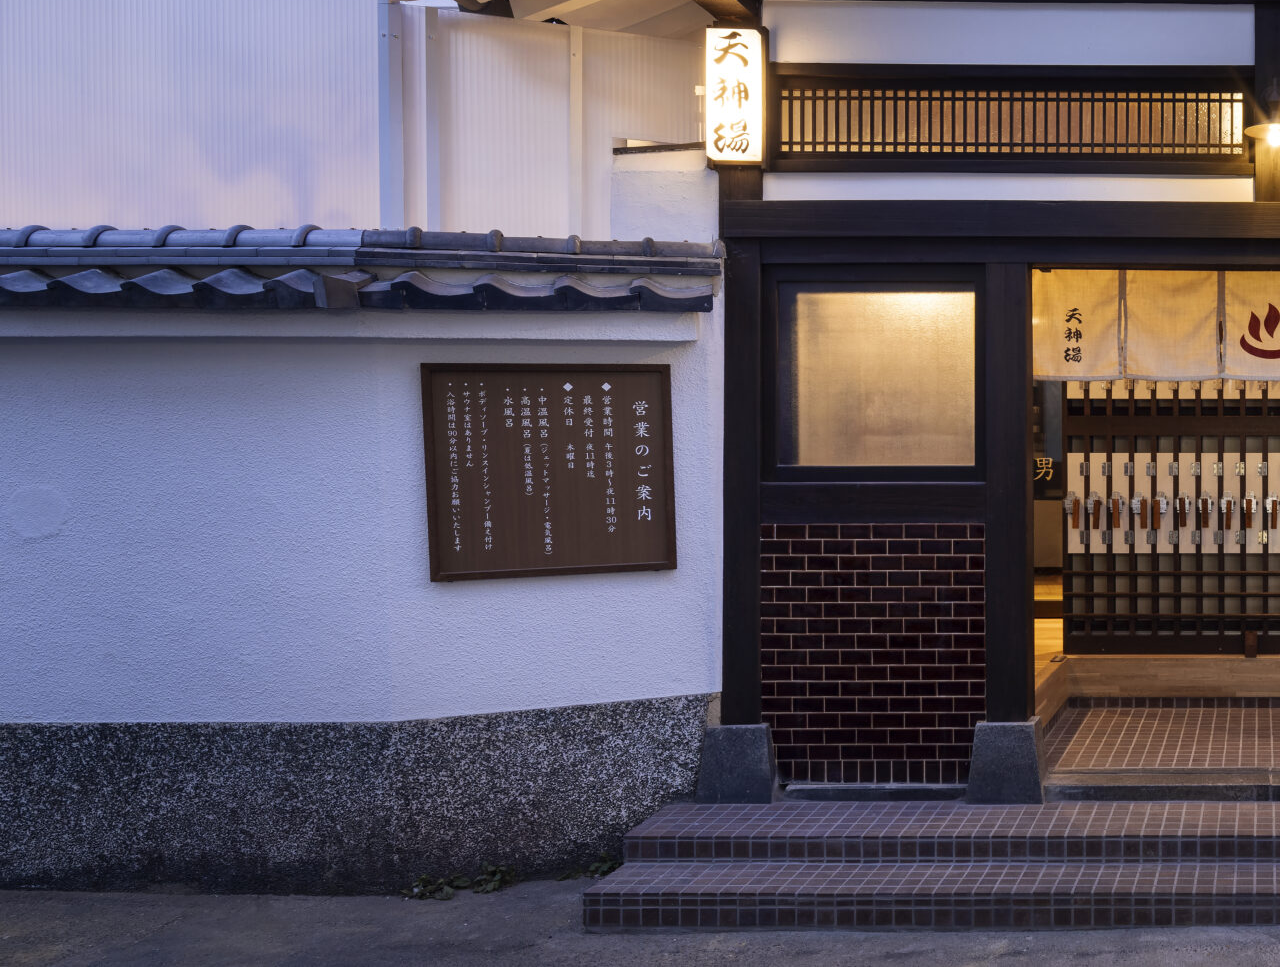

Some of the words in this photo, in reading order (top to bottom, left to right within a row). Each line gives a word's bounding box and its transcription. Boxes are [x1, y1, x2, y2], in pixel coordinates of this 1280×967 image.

[714, 31, 750, 154] 天神湯
[1064, 308, 1083, 363] 天神湯
[503, 396, 515, 428] 水風呂
[563, 396, 575, 426] 定休日
[583, 396, 594, 438] 最終受付
[601, 396, 614, 438] 営業時間
[632, 401, 652, 521] 営業のご案内
[1033, 458, 1053, 481] 男
